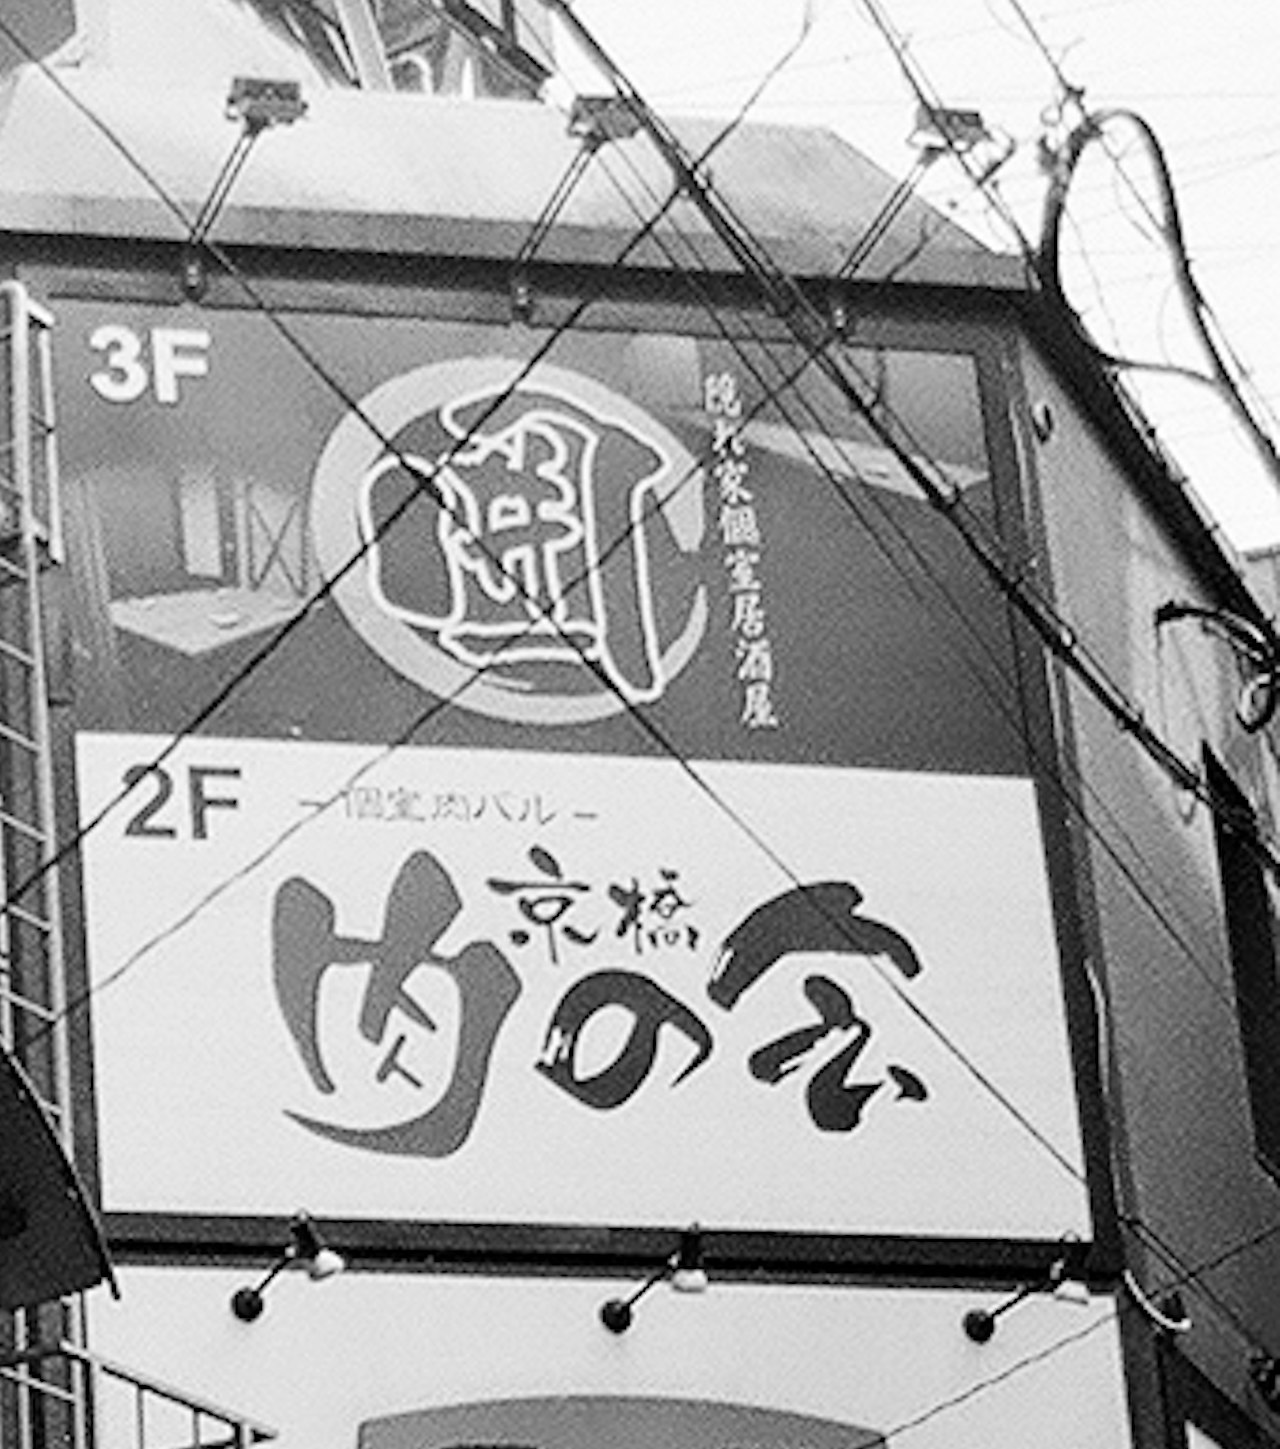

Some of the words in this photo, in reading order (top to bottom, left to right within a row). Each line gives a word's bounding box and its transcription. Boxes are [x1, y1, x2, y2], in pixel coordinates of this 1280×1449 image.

[89, 325, 211, 405] 3F
[122, 764, 243, 840] 2F
[486, 845, 703, 964] 京橋
